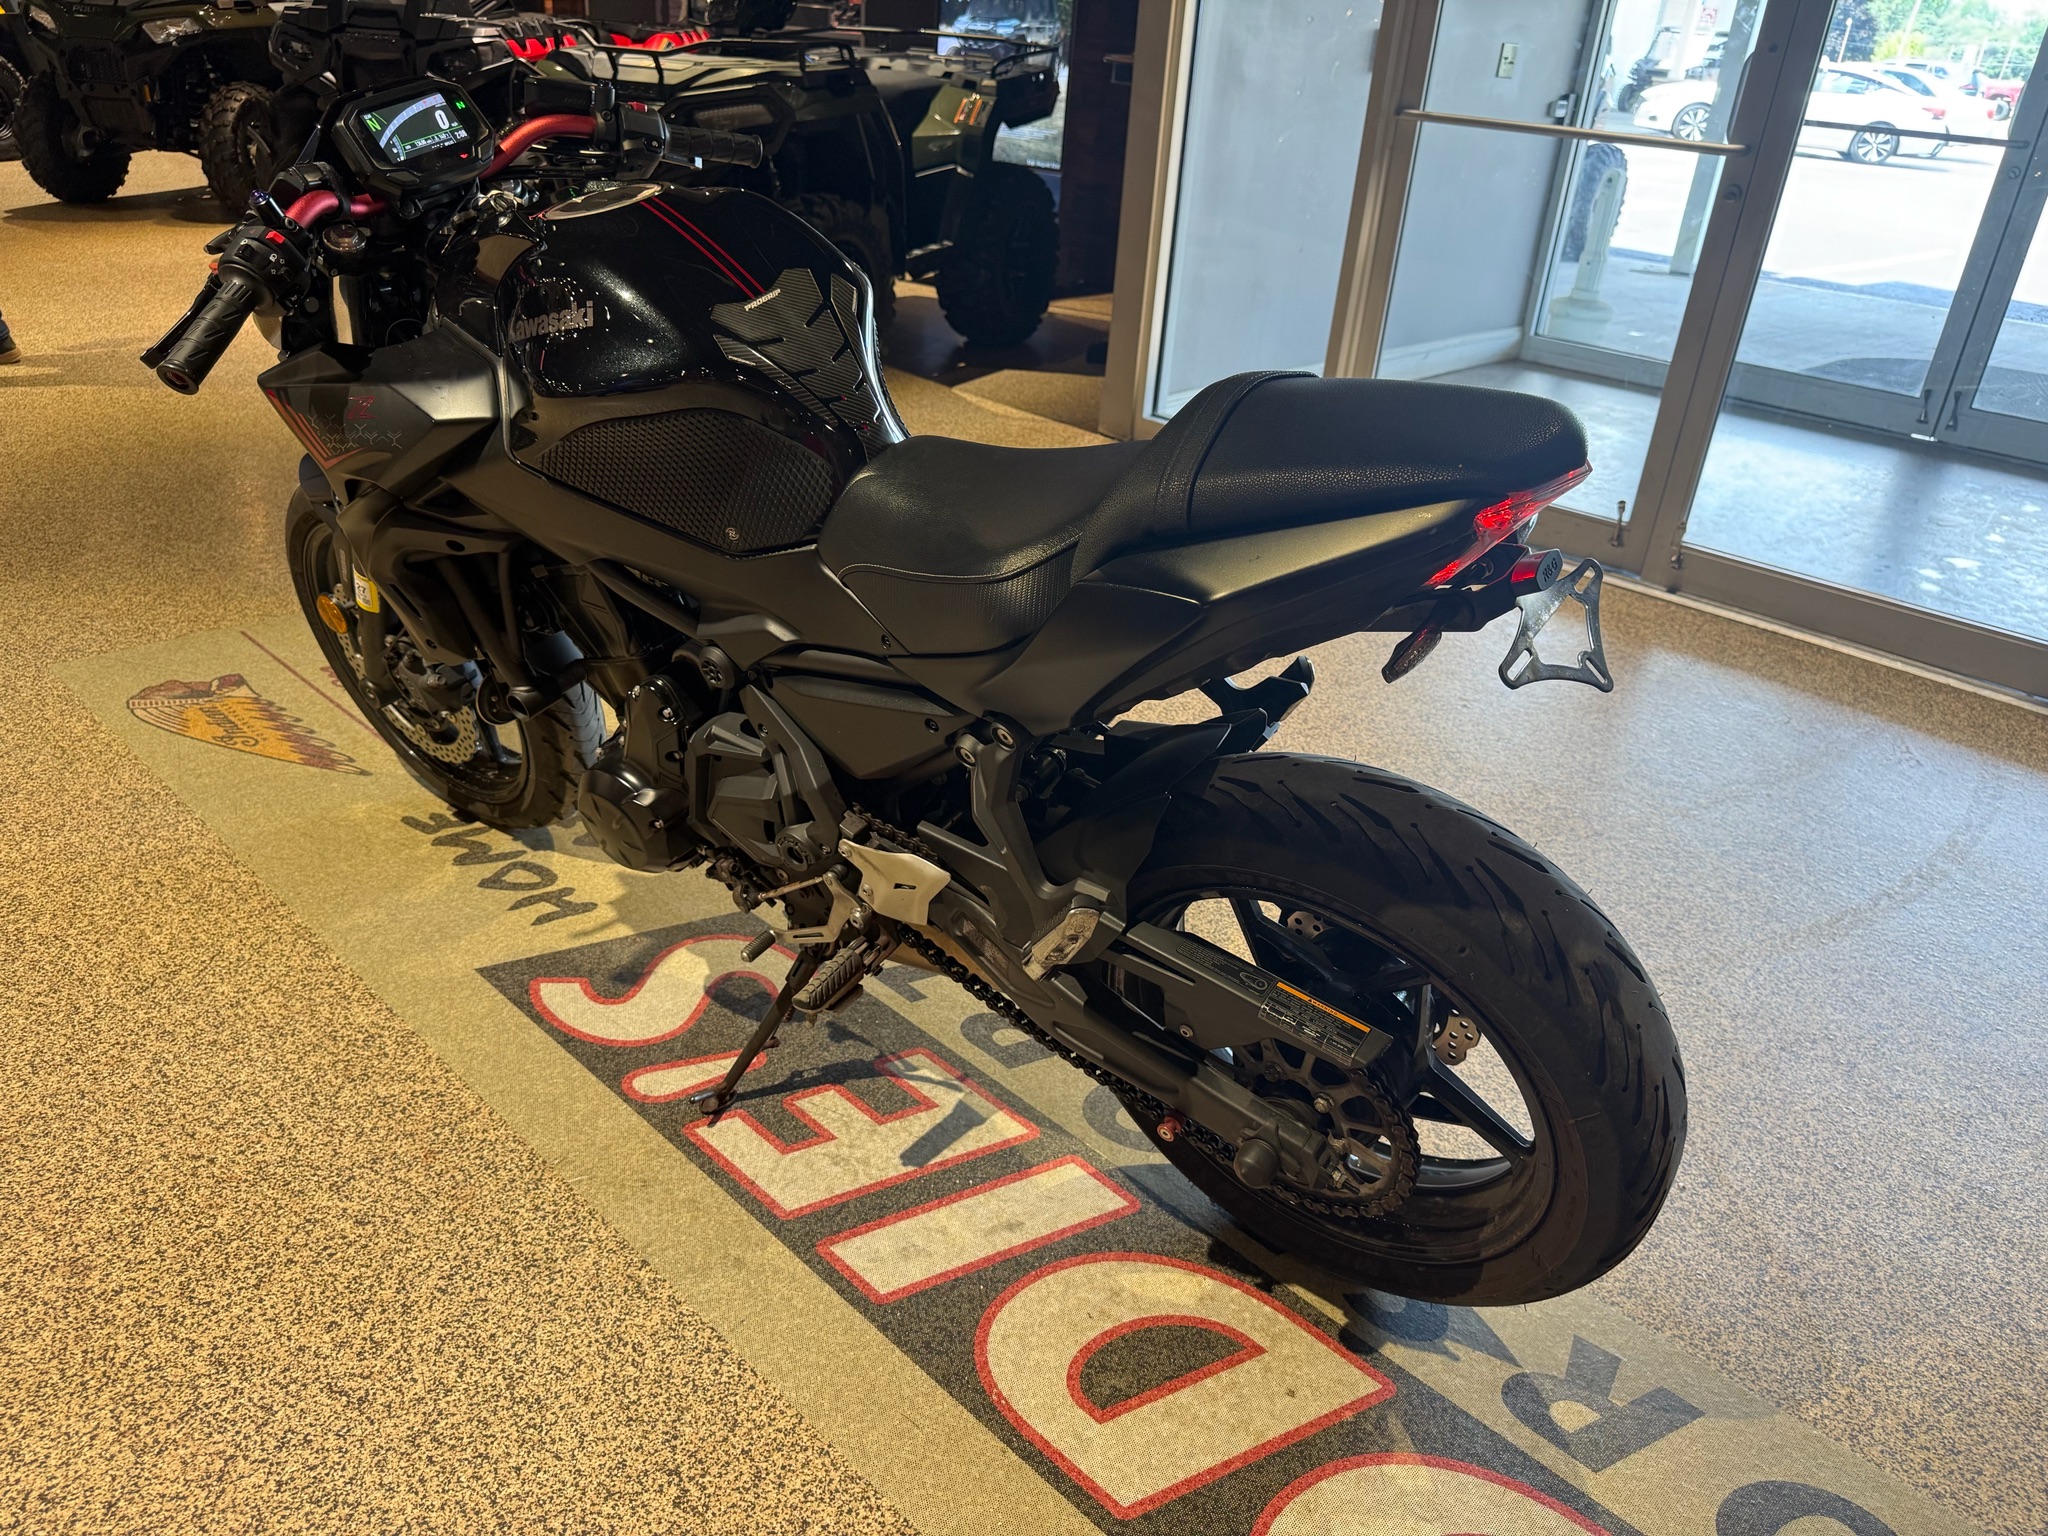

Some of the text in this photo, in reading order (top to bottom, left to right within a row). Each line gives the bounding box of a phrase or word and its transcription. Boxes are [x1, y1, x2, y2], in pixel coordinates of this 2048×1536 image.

[366, 117, 382, 132] N
[434, 109, 450, 130] 0
[744, 288, 781, 312] PROGRIP
[507, 300, 594, 343] Kawasaki
[1542, 557, 1558, 583] R&G
[199, 706, 259, 746] Indian
[401, 812, 598, 926] HOME
[1312, 1000, 1338, 1016] WARNING
